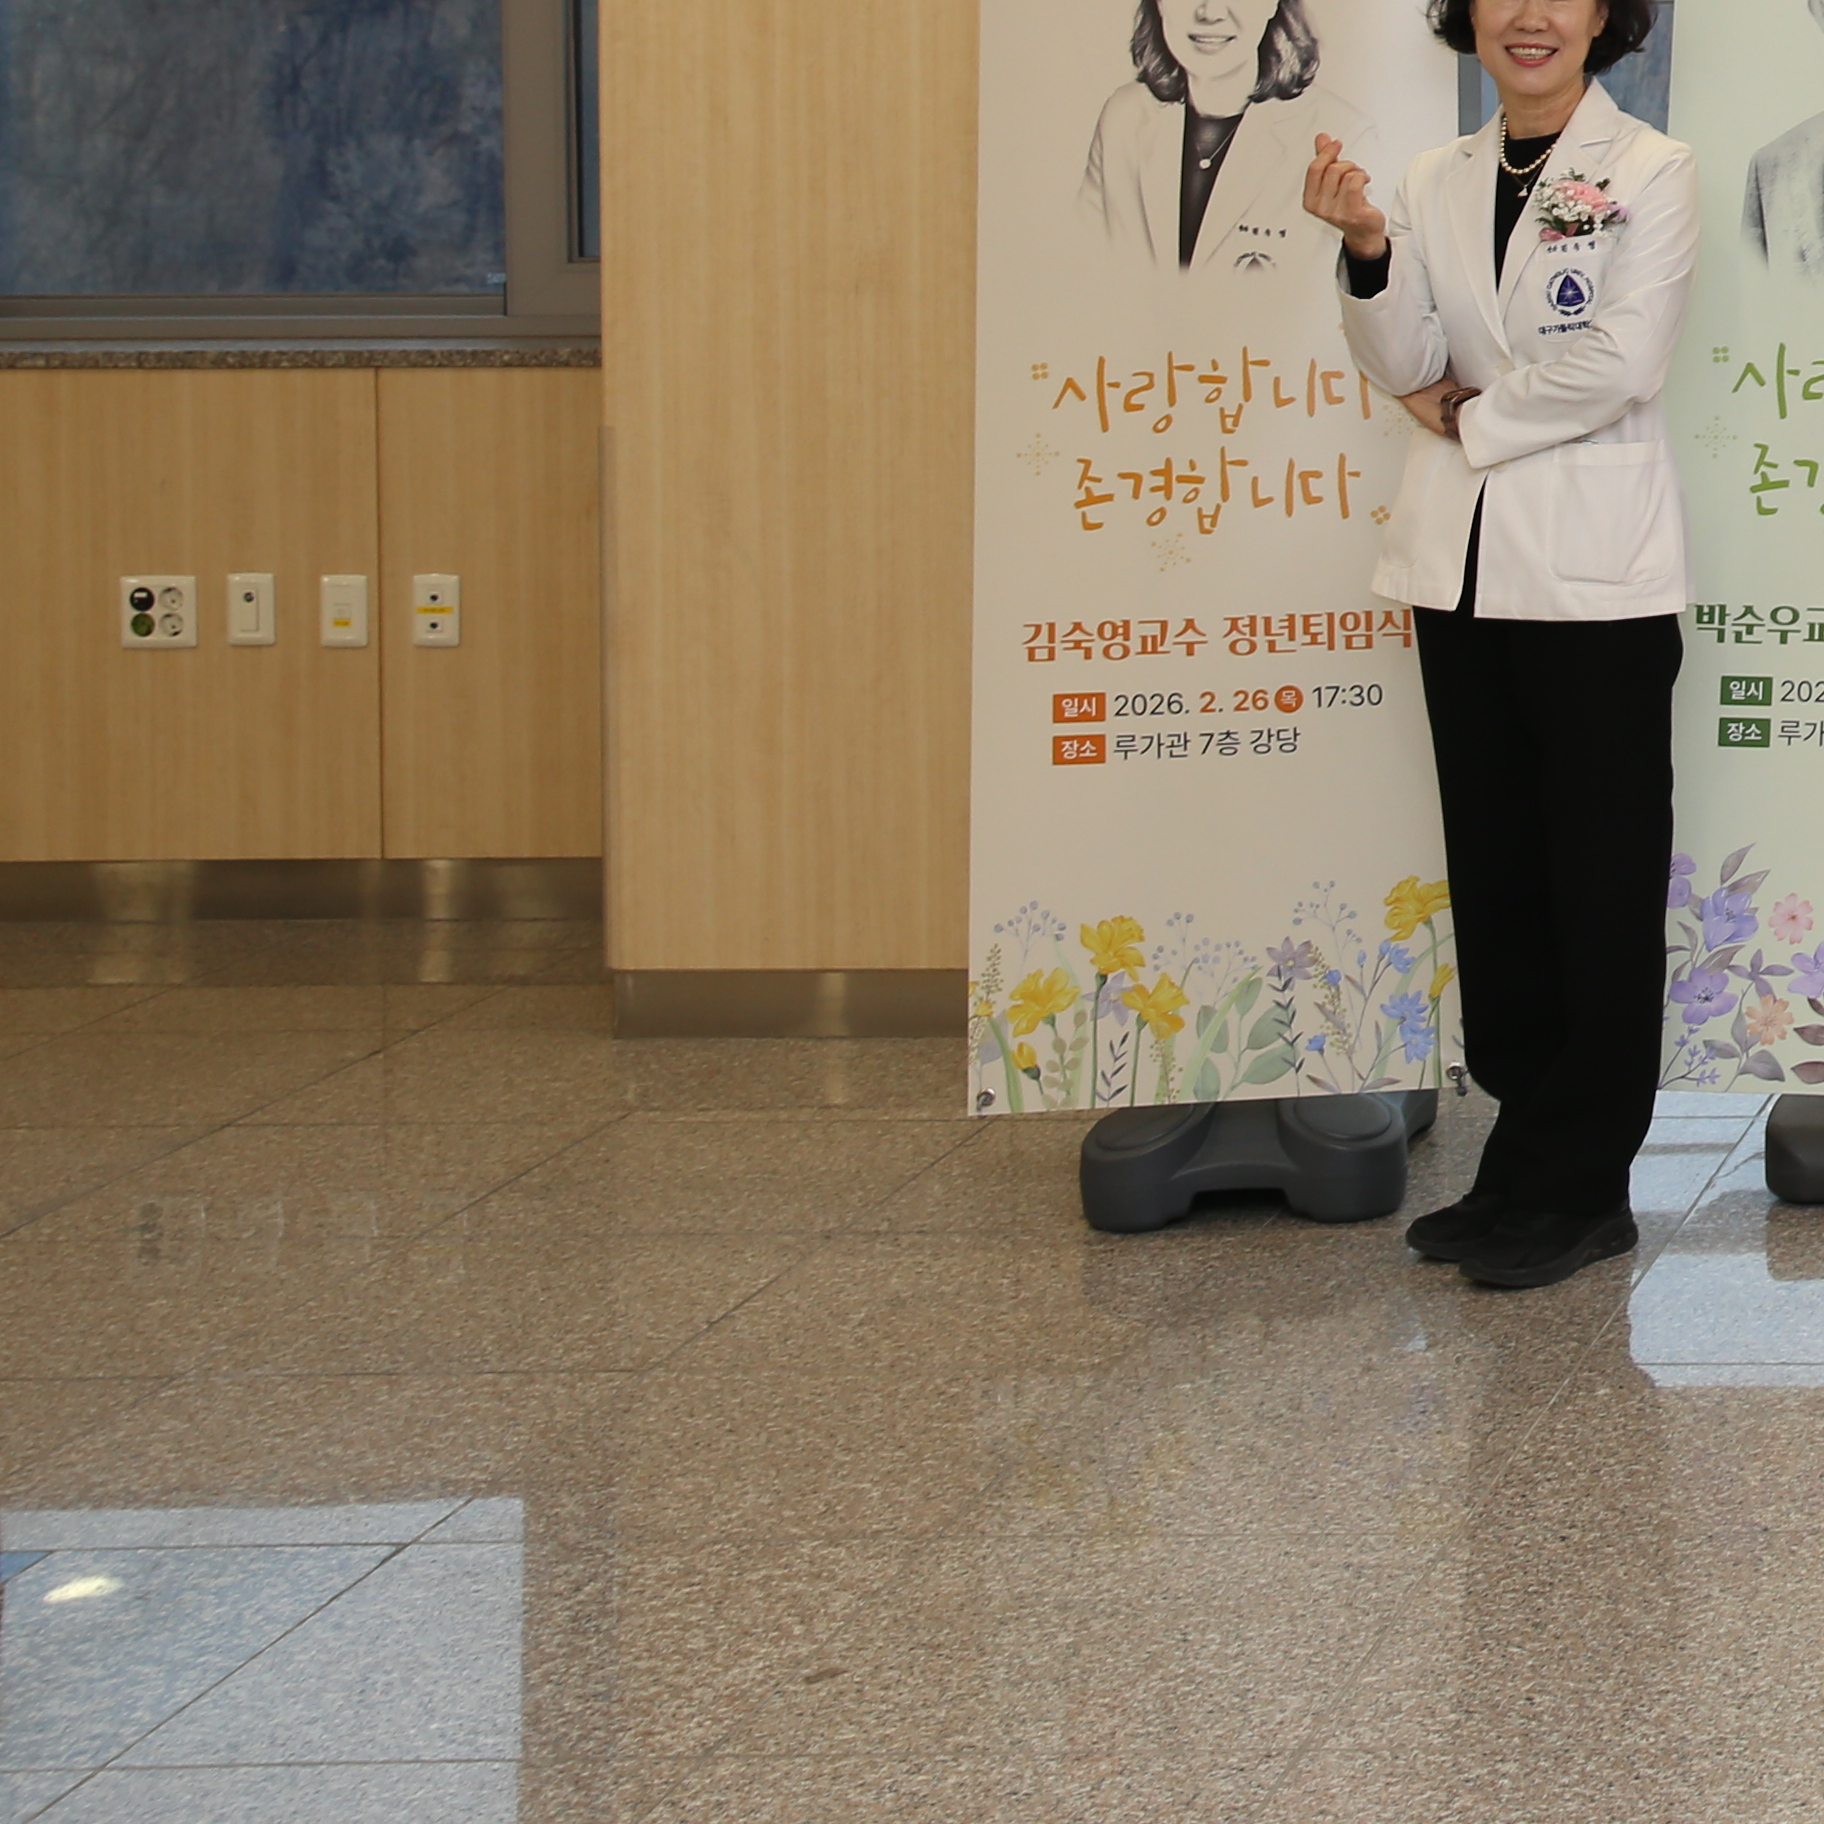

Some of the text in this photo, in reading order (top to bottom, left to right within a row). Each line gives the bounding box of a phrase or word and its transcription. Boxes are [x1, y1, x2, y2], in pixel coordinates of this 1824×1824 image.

[1074, 446, 1360, 534] 존경합니다
[1023, 608, 1413, 662] 김숙영교수 정년퇴임식
[1061, 696, 1096, 718] 일시
[1115, 693, 1189, 716] 2026.
[1200, 692, 1223, 712] 2.
[1234, 690, 1268, 711] 26
[1313, 684, 1382, 707] 17:30
[1729, 680, 1764, 701] 일시
[1060, 727, 1300, 760] 장소 루가관 7층 강당
[1727, 722, 1762, 742] 장소
